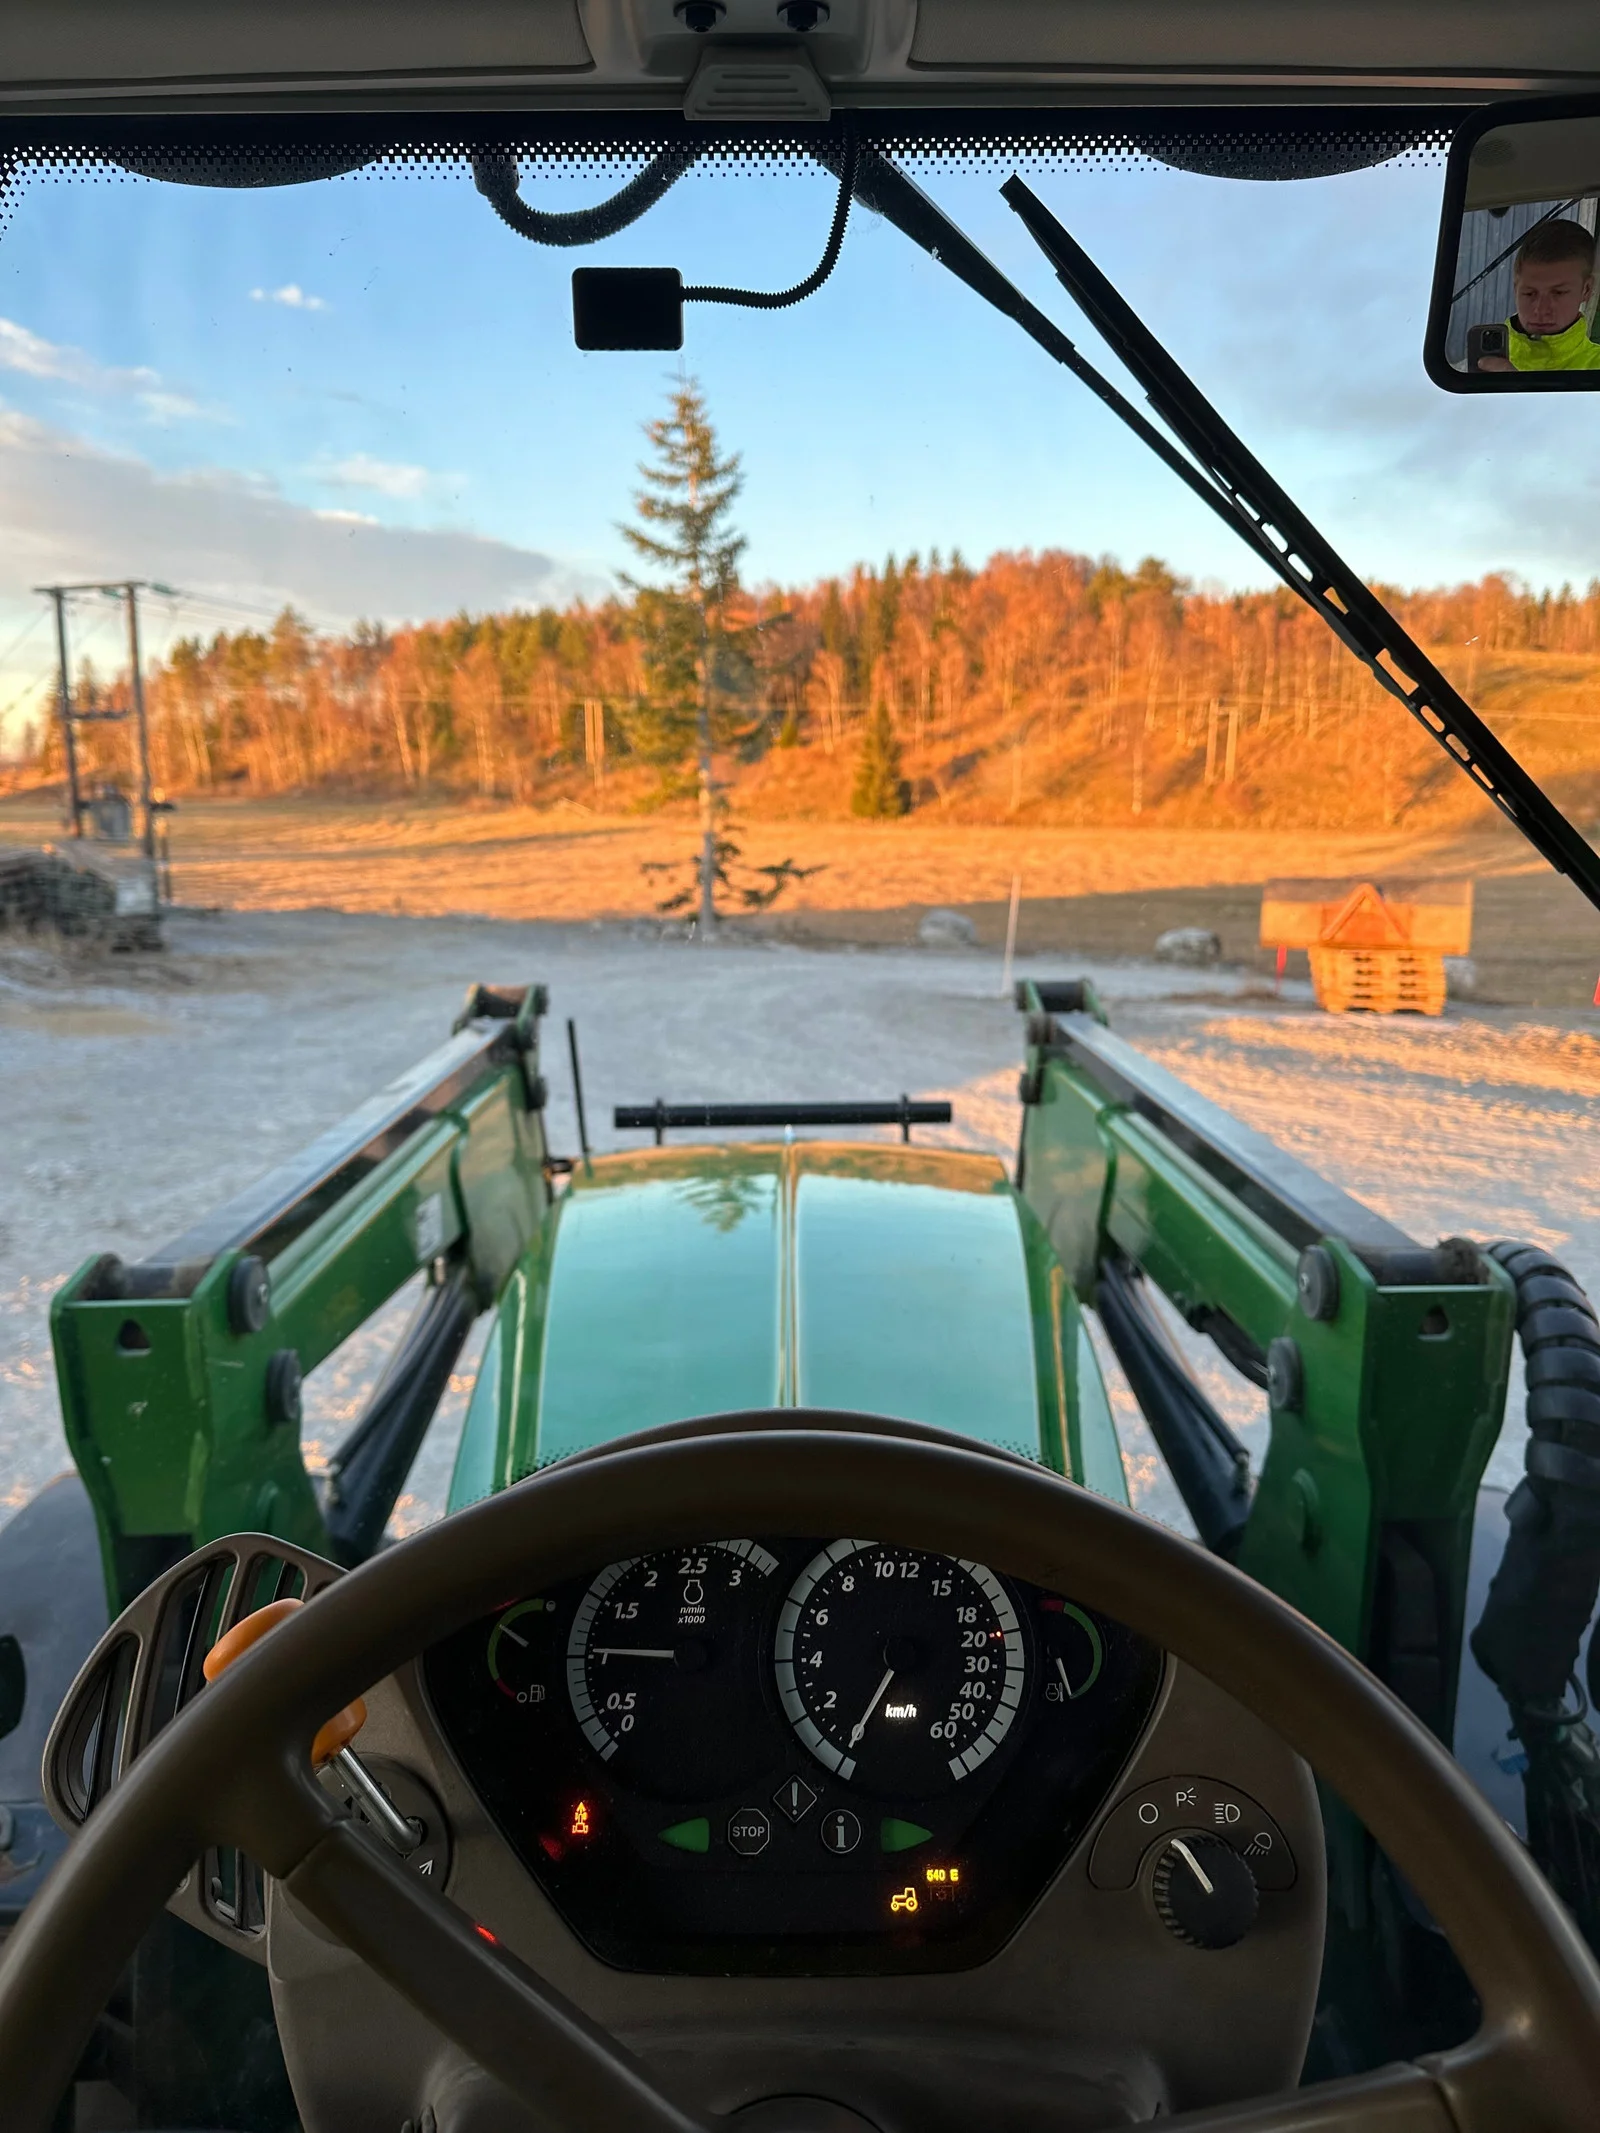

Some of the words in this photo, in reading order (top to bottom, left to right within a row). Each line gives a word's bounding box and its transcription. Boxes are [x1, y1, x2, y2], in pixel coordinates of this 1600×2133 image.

[678, 1557, 708, 1574] 2.5
[874, 1561, 895, 1578] 10
[899, 1562, 920, 1579] 12
[644, 1571, 659, 1587] 2
[729, 1569, 742, 1586] 3
[841, 1575, 855, 1592] 8
[931, 1580, 952, 1596] 15
[614, 1602, 639, 1619] 1.5
[680, 1606, 706, 1615] n/min
[815, 1608, 829, 1626] 6
[956, 1607, 977, 1623] 18
[678, 1615, 706, 1624] x1000
[961, 1631, 987, 1648] 20
[809, 1651, 823, 1668] 4
[964, 1656, 990, 1673] 30
[959, 1682, 986, 1699] 40
[606, 1692, 637, 1710] 0.5
[823, 1691, 837, 1708] 2
[885, 1704, 917, 1718] km/h
[948, 1703, 975, 1720] 50
[620, 1714, 635, 1732] 0
[930, 1721, 957, 1739] 60
[732, 1826, 765, 1838] STOP
